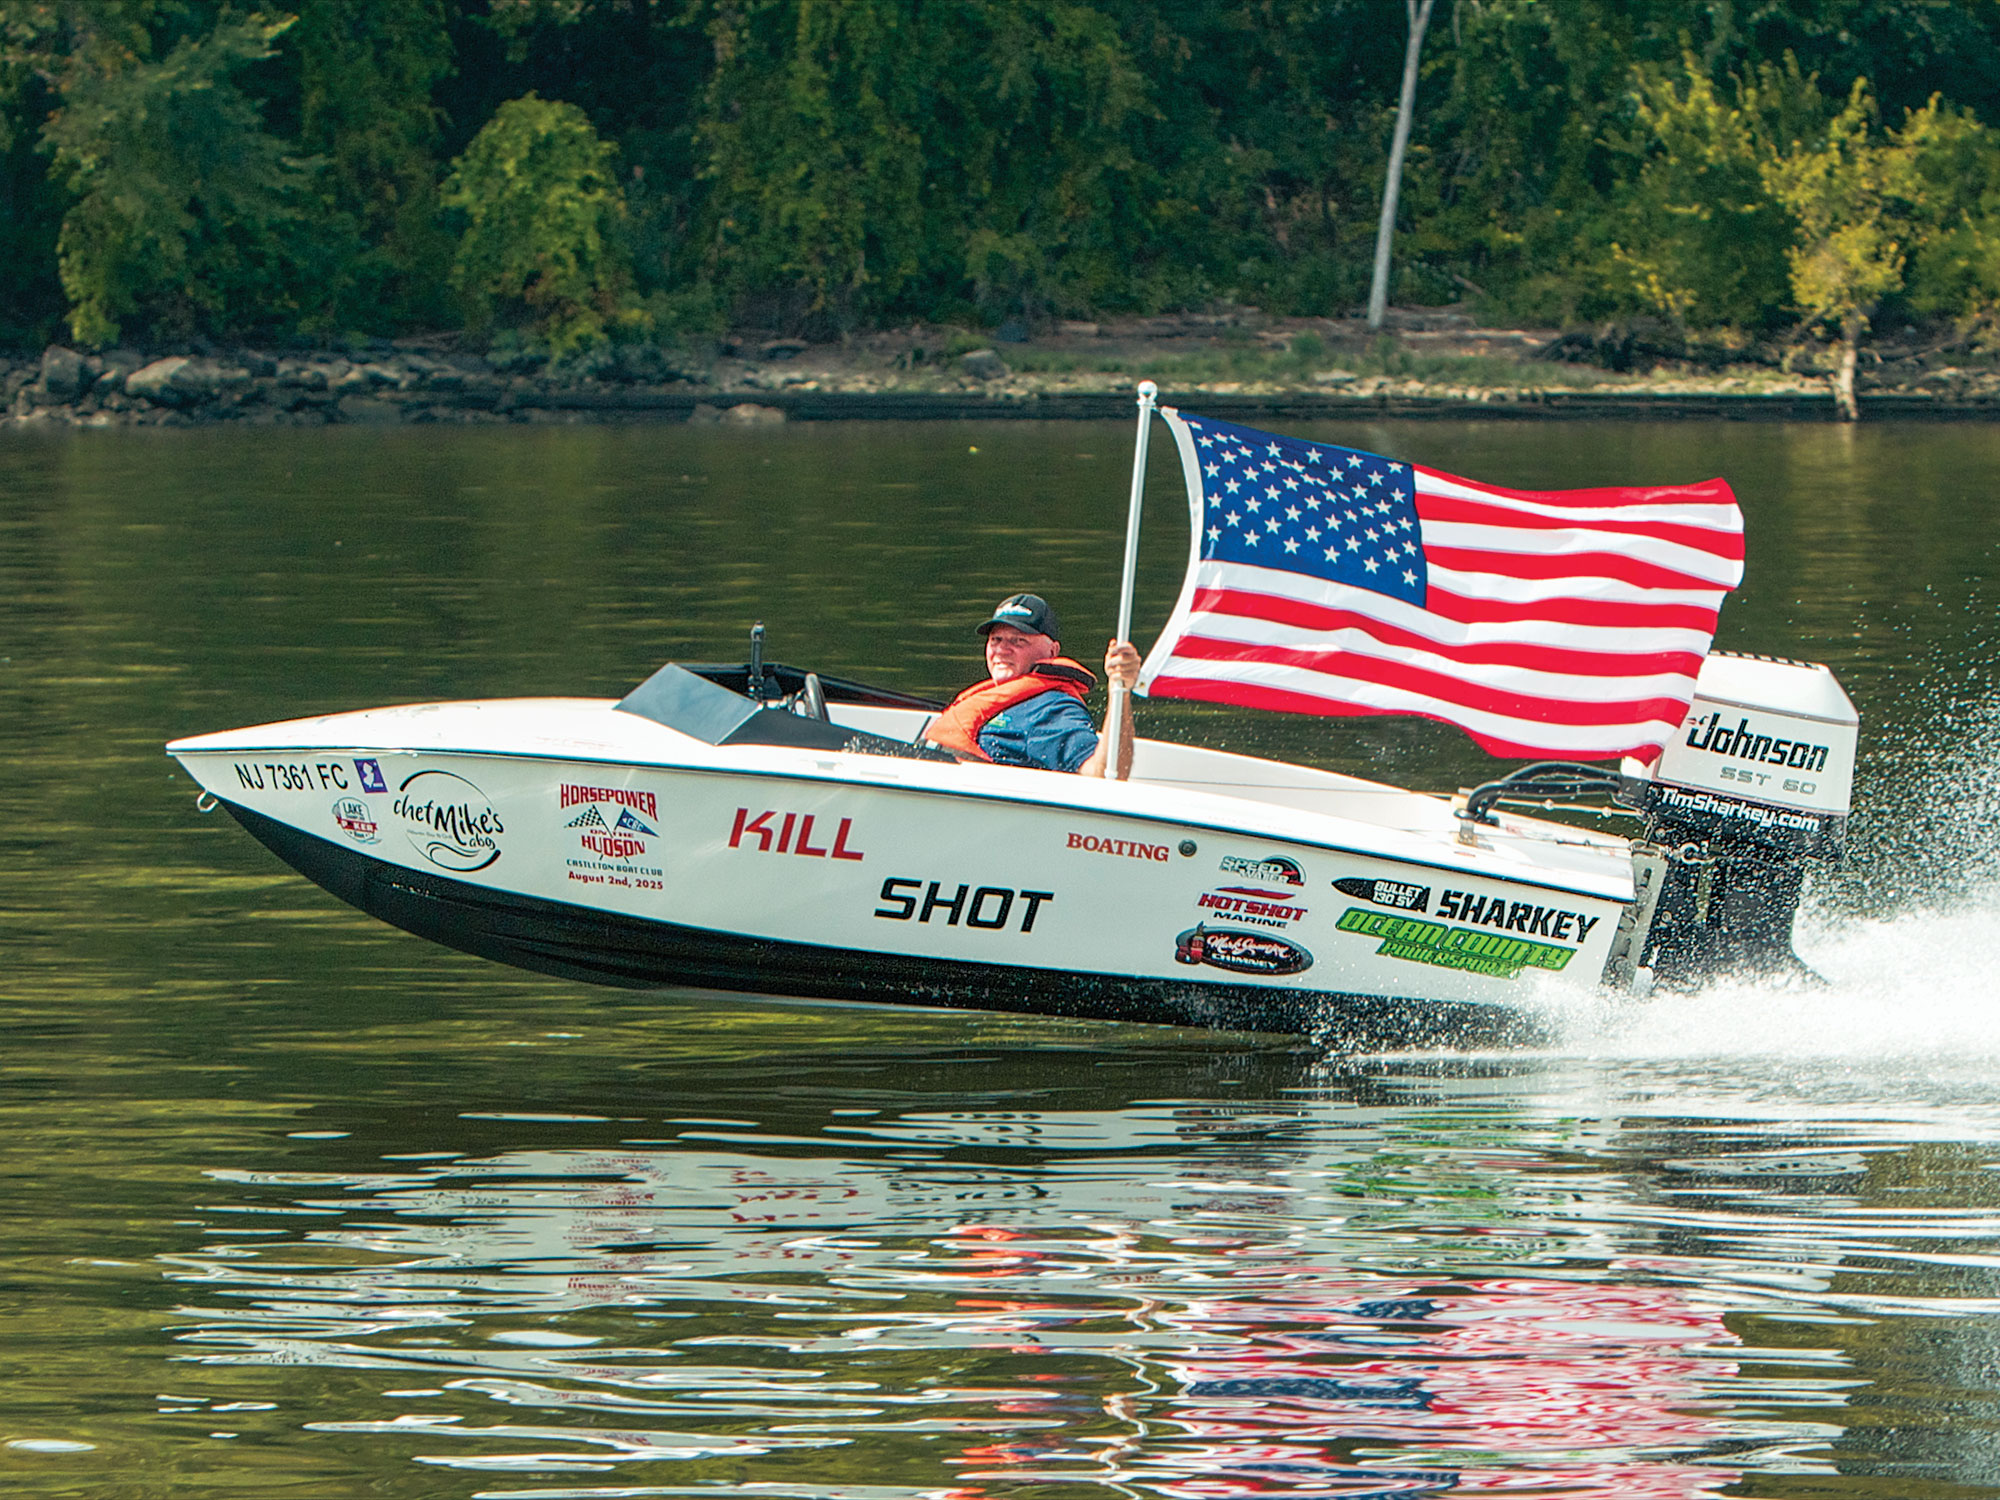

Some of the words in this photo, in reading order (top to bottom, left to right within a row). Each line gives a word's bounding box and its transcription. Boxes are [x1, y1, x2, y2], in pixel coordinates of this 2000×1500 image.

[1686, 712, 1829, 773] Johnson
[234, 763, 264, 790] NJ
[265, 763, 314, 790] 7361
[316, 763, 349, 790] FC
[1720, 766, 1772, 786] SST
[1782, 777, 1817, 795] 60
[560, 783, 659, 822] HORSEPOWER
[1660, 787, 1820, 832] TimSharkey.com
[340, 819, 374, 832] PKER
[393, 794, 434, 825] chef
[434, 803, 504, 846] Mike's
[728, 807, 864, 861] KILL
[581, 835, 645, 857] HUDSON
[1066, 832, 1169, 862] BOATING
[566, 858, 614, 871] CASTLETON
[616, 865, 638, 874] BOAT
[640, 867, 663, 876] CLUB
[1219, 856, 1284, 875] SPEED
[568, 870, 604, 884] August
[608, 875, 632, 888] 2nd,
[635, 878, 664, 890] 2025
[1374, 880, 1423, 898] BULLET
[874, 877, 1054, 933] SHOT
[1197, 893, 1308, 921] HOTSHOT
[1372, 891, 1395, 904] 130
[1395, 895, 1415, 908] SV
[1213, 911, 1288, 929] MARINE
[1435, 889, 1600, 943] SHARKEY
[1339, 911, 1447, 947] OCEAN
[1443, 928, 1575, 970] COUNTY
